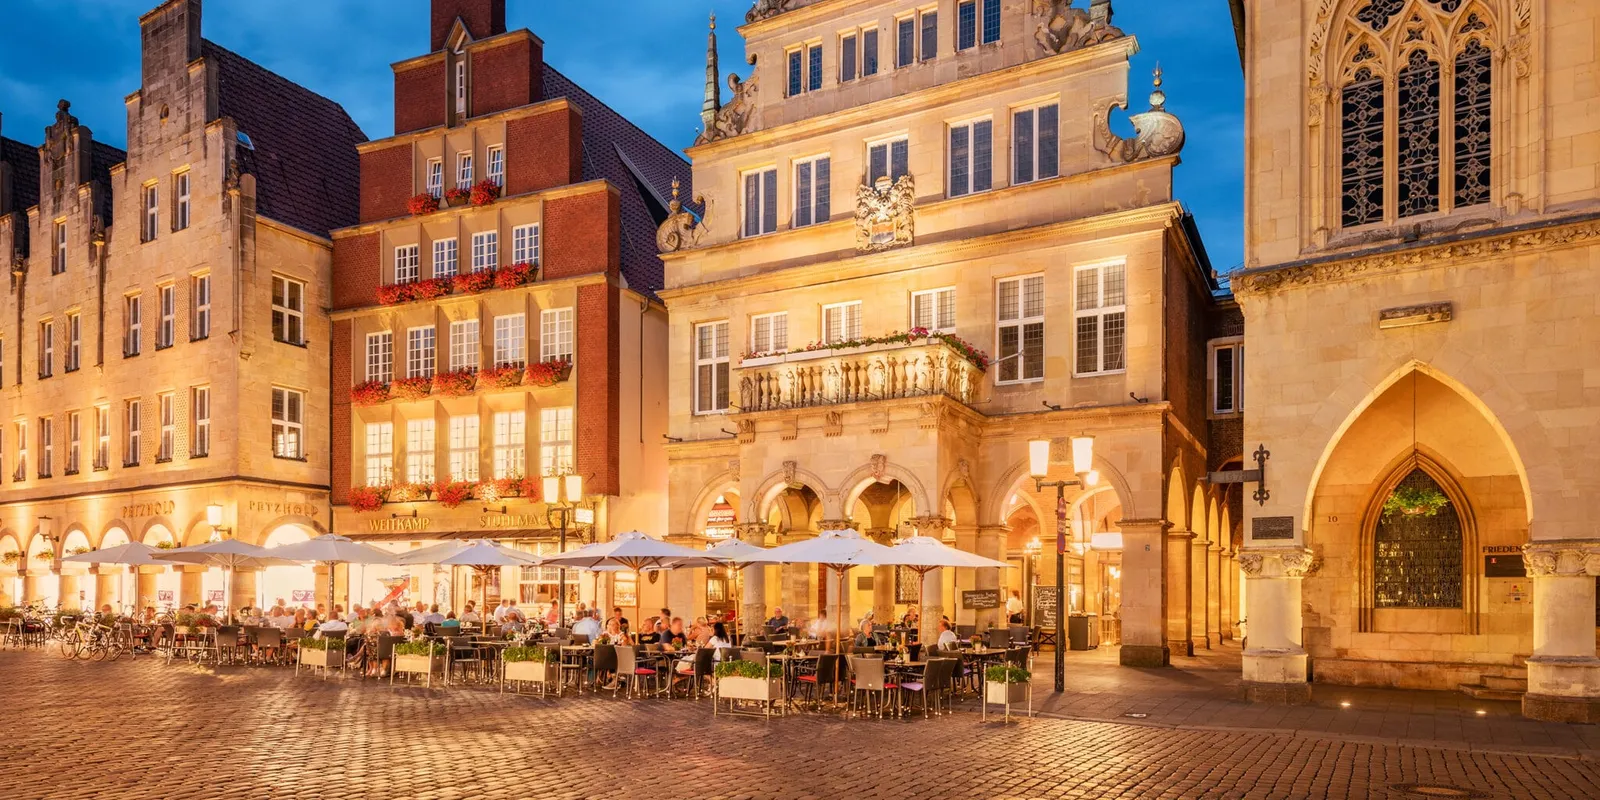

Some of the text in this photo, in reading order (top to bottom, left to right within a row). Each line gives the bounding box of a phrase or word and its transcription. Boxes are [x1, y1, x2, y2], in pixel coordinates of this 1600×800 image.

[122, 500, 175, 518] PETZHOLD
[249, 501, 318, 517] PETZHOLD
[369, 518, 430, 531] WEITKAMP
[480, 513, 567, 528] STUHLMAC
[1483, 545, 1522, 553] FRIEDEN
